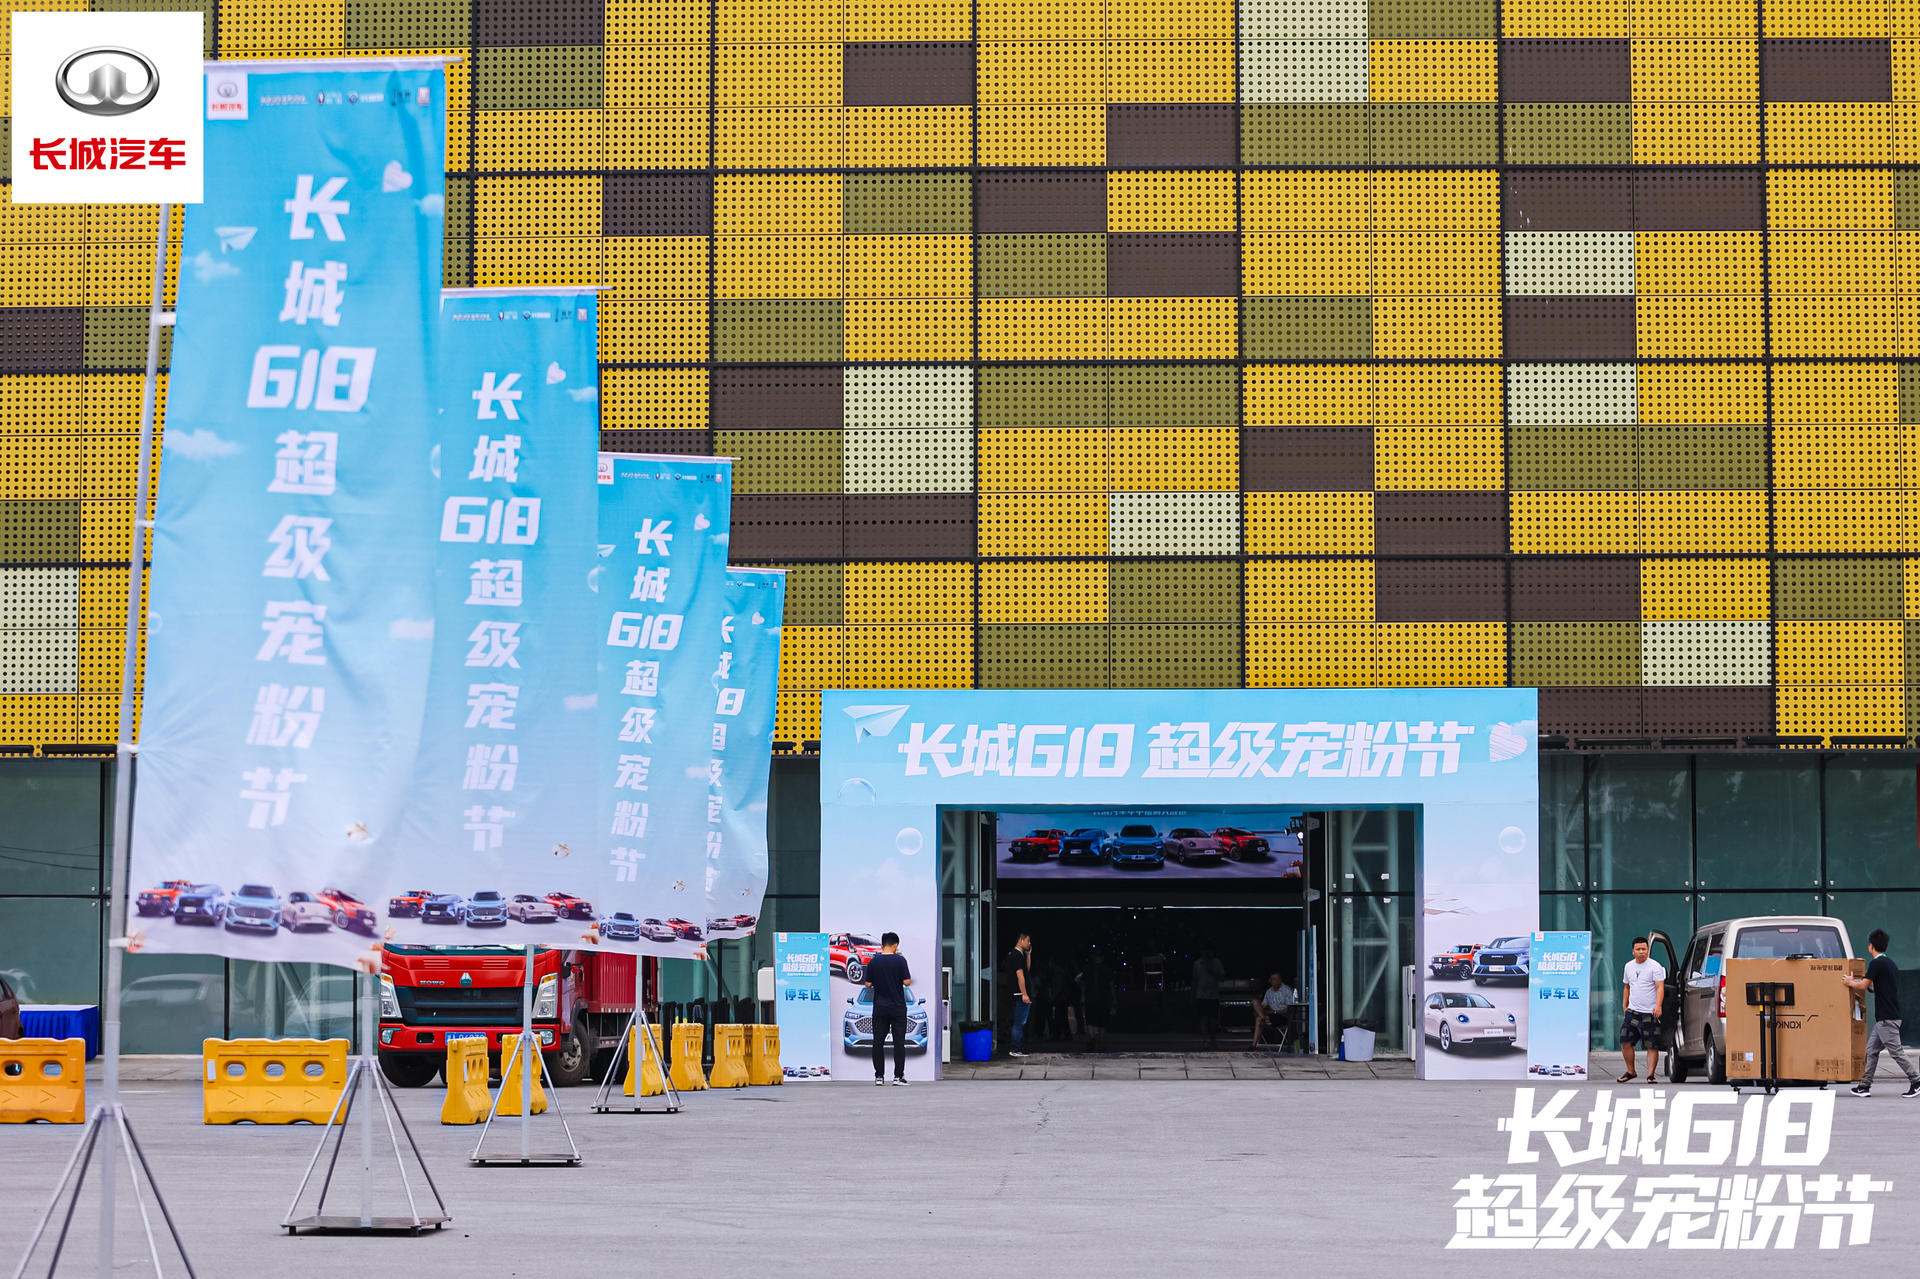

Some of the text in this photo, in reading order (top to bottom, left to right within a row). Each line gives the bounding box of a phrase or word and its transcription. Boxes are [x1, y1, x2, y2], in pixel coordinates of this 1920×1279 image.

[785, 988, 822, 1001] 停车区
[1540, 987, 1580, 999] 停车区
